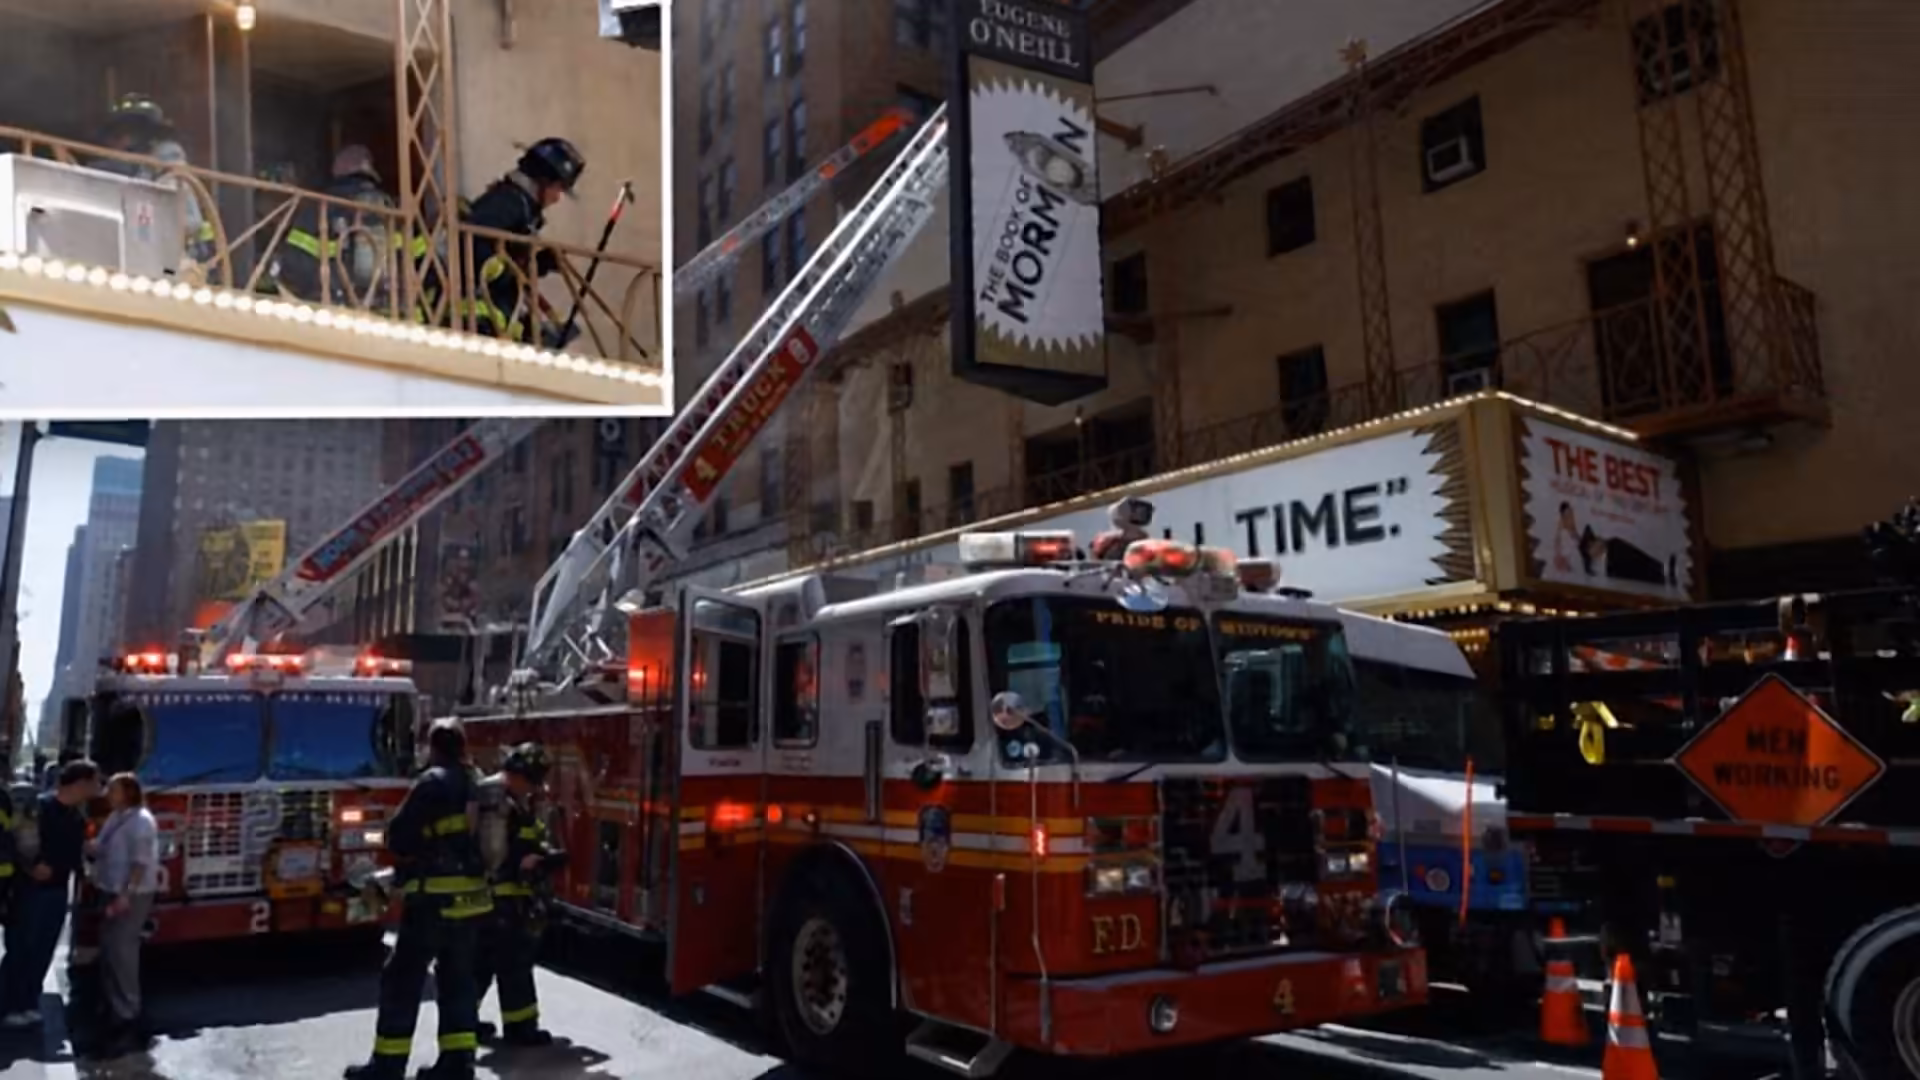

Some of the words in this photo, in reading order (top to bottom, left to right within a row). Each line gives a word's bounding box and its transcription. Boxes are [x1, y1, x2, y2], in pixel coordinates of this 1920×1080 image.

[980, 264, 1005, 304] THE
[999, 209, 1025, 266] BOOK
[1016, 174, 1037, 203] OF
[694, 455, 718, 482] 4
[711, 358, 787, 447] TRUCK
[1543, 436, 1601, 486] THE
[1603, 453, 1662, 500] BEST
[1745, 726, 1808, 755] MEN
[1713, 763, 1842, 791] WORKING
[1210, 786, 1267, 883] 4
[250, 900, 271, 933] 2
[1273, 978, 1295, 1014] 4
